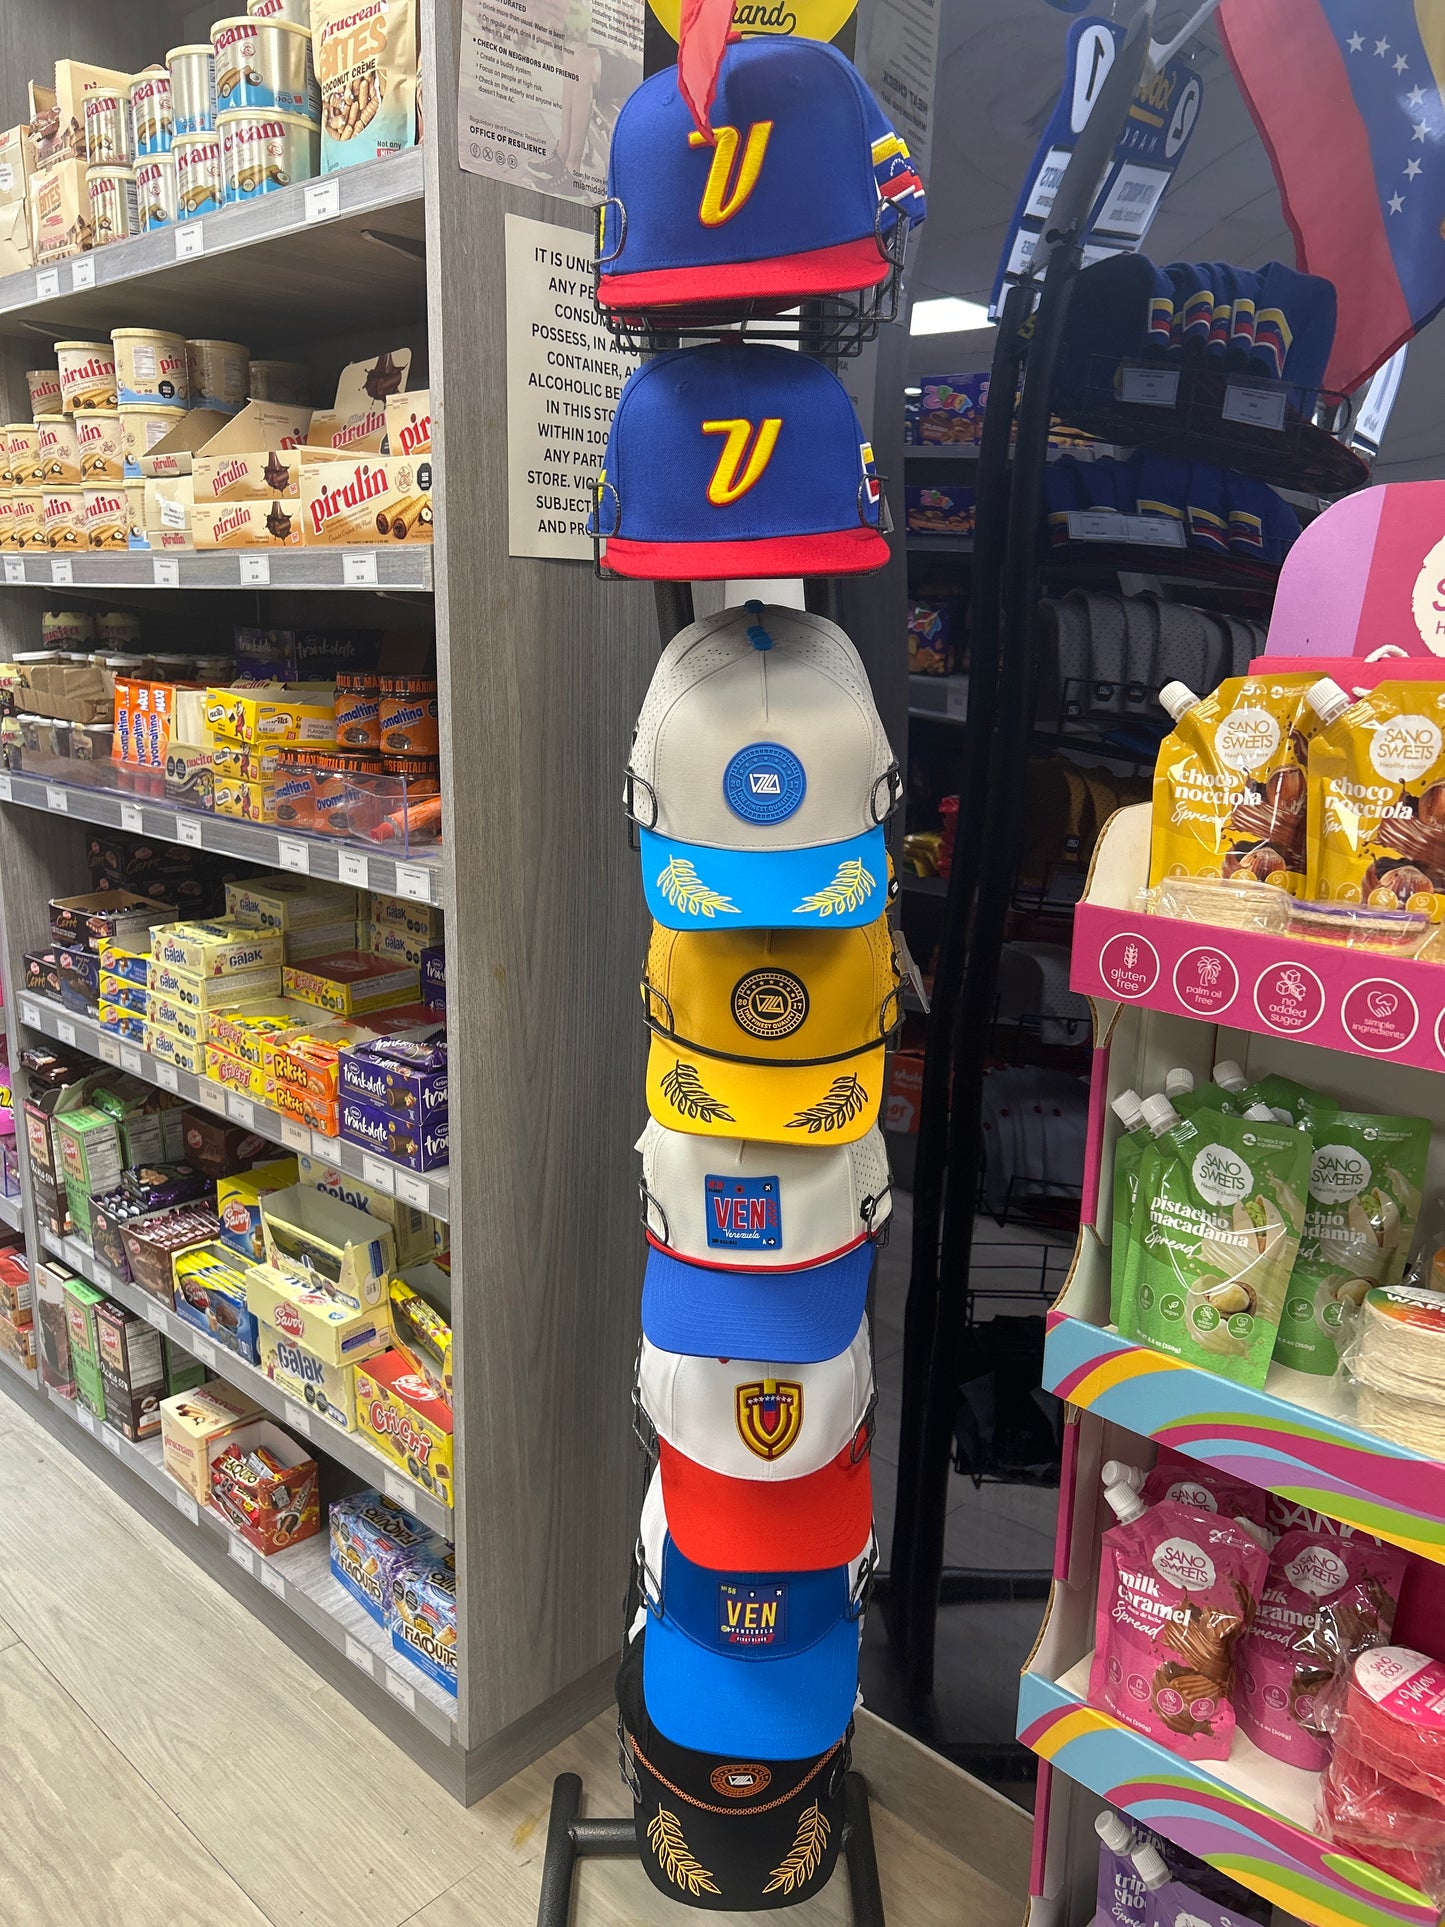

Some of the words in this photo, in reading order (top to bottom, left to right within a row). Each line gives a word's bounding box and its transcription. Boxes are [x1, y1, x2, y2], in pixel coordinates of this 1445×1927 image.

[320, 16, 388, 80] BITES
[478, 37, 497, 52] CHECK
[500, 46, 507, 56] ON
[509, 49, 541, 69] NEIGHBORS
[542, 62, 554, 73] AND
[556, 67, 580, 83] FRIENDS
[480, 52, 495, 63] Create
[500, 59, 514, 72] buddy
[322, 71, 350, 95] COCONUT
[352, 58, 377, 78] CRÈME
[480, 63, 493, 75] Focus
[501, 72, 516, 84] people
[523, 79, 533, 90] high
[479, 75, 493, 87] Check
[501, 83, 509, 92] the
[510, 86, 524, 99] elderly
[526, 92, 534, 101] and
[536, 96, 552, 108] anyone
[553, 101, 563, 111] who
[470, 124, 495, 141] OFFICE
[497, 133, 507, 144] OF
[508, 137, 547, 157] RESILIENCE
[535, 247, 547, 263] IT
[550, 251, 563, 267] IS
[549, 277, 577, 296] ANY
[532, 324, 590, 351] POSSESS,
[594, 336, 606, 351] IN
[547, 352, 622, 380] CONTAINER,
[528, 372, 602, 398] ALCOHOLIC
[546, 400, 560, 415] IN
[563, 403, 591, 419] THIS
[332, 411, 386, 449] pirulin
[538, 423, 584, 442] WITHIN
[153, 456, 177, 472] pirulin
[544, 449, 571, 464] ANY
[702, 418, 783, 507] V
[212, 459, 250, 497] pirulin
[528, 470, 571, 488] STORE.
[309, 465, 389, 534] pirulin
[536, 495, 592, 513] SUBJECT
[213, 507, 252, 543] pirulin
[538, 519, 567, 534] AND
[162, 533, 186, 548] pirulin
[156, 689, 167, 713] MAXI
[1228, 721, 1271, 736] SANO
[1384, 728, 1433, 745] SANO
[1222, 735, 1273, 750] SWEETS
[1377, 744, 1434, 760] SWEETS
[187, 755, 213, 769] nucita
[1178, 768, 1239, 789] choco
[1174, 784, 1262, 807] nocciola
[1330, 776, 1394, 802] choco
[746, 802, 768, 812] FINEST
[769, 792, 792, 812] QUALITY
[1324, 795, 1413, 821] nocciola
[1170, 801, 1232, 827] Spread
[240, 899, 261, 914] Galak
[386, 904, 407, 921] Galak
[385, 936, 406, 951] Galak
[164, 947, 187, 965] Galak
[229, 950, 263, 968] Galak
[160, 975, 179, 991] Galak
[1111, 968, 1147, 984] gluten
[1117, 978, 1139, 992] free
[1186, 985, 1209, 997] palm
[1211, 990, 1223, 999] oil
[1195, 995, 1214, 1006] free
[1269, 1004, 1307, 1019] added
[1282, 998, 1297, 1007] no
[159, 1005, 178, 1022] Galak
[744, 1009, 753, 1021] THE
[751, 1019, 772, 1029] FINEST
[773, 1012, 795, 1029] QUALITY
[1271, 1013, 1303, 1026] sugar
[1352, 1023, 1405, 1041] ingredients
[1364, 1018, 1396, 1031] simple
[156, 1037, 175, 1054] Galak
[274, 1054, 309, 1088] Rikiti
[277, 1088, 304, 1116] Rikiti
[1206, 1153, 1242, 1176] SANO
[1317, 1156, 1361, 1174] SANO
[1200, 1166, 1245, 1190] SWEETS
[1312, 1170, 1364, 1186] SWEETS
[224, 1208, 252, 1229] Savoy
[714, 1197, 767, 1230] VEN
[1151, 1195, 1230, 1230] pistachio
[723, 1229, 761, 1240] Venezuela
[1150, 1210, 1249, 1248] macadamia
[1145, 1224, 1202, 1257] Spread
[275, 1310, 305, 1333] Savoy
[278, 1343, 325, 1385] Galak
[1165, 1547, 1206, 1569] SANO
[1300, 1554, 1338, 1572] SANO
[340, 1554, 383, 1600] FLAQUITO
[1160, 1559, 1208, 1583] SWEETS
[1292, 1564, 1341, 1585] SWEETS
[1118, 1570, 1160, 1598] milk
[726, 1600, 778, 1628] VEN
[1118, 1584, 1192, 1627] caramel
[1112, 1600, 1165, 1640] Spread
[1147, 1615, 1162, 1624] leche
